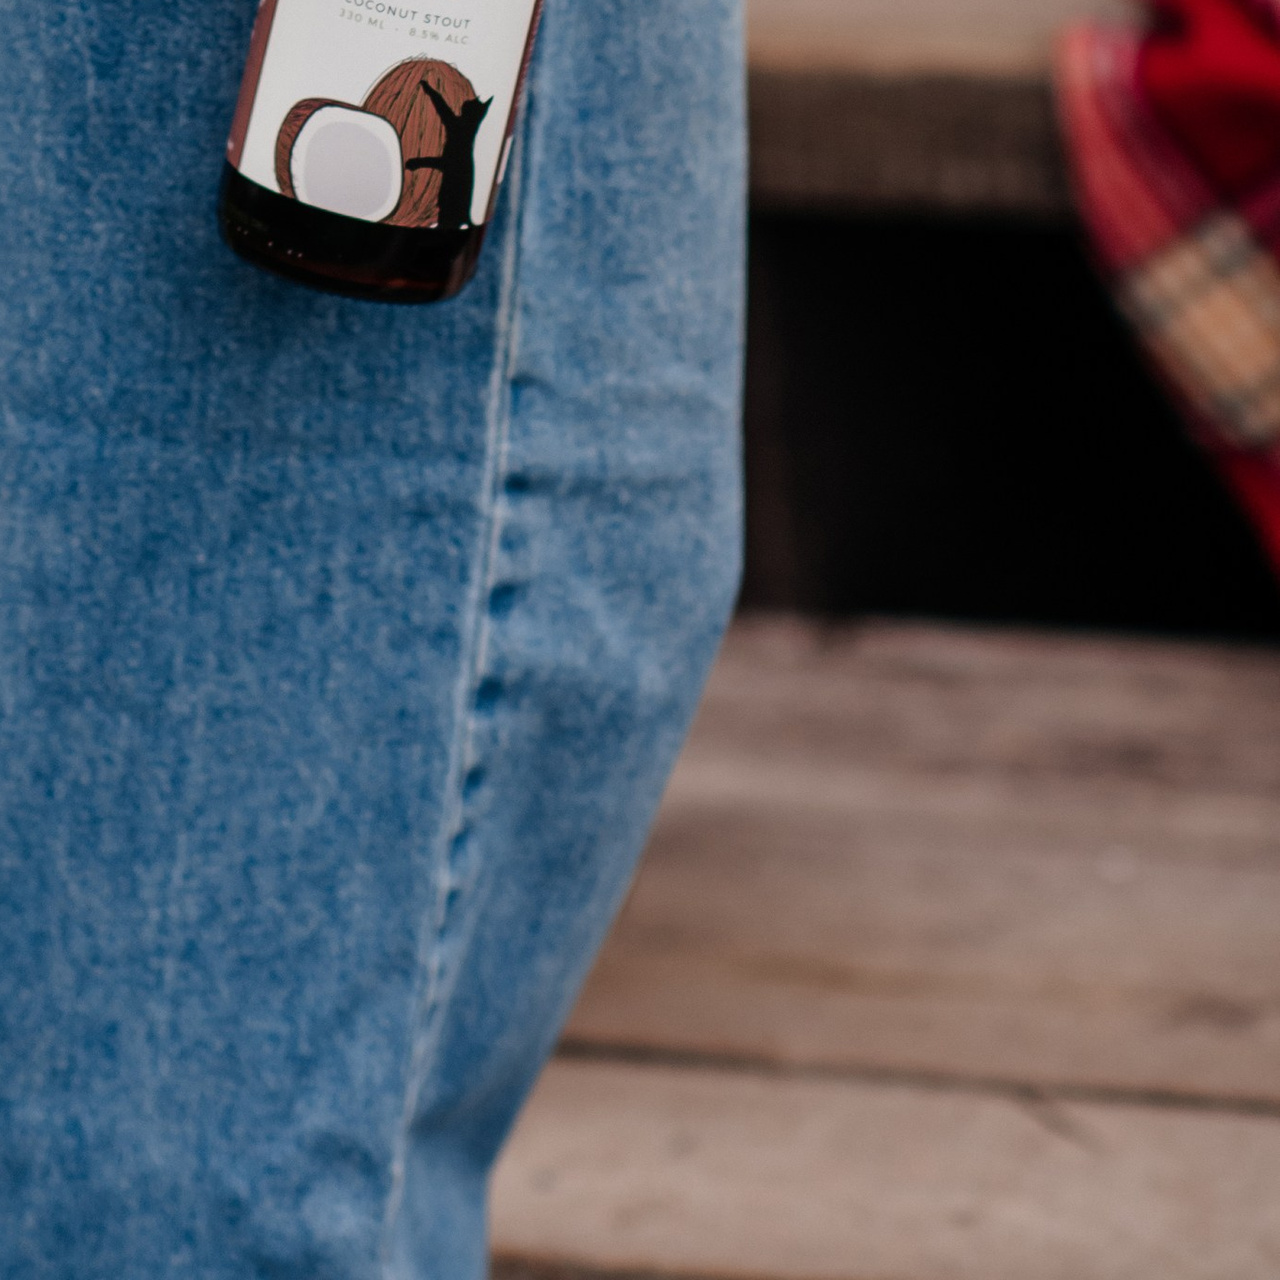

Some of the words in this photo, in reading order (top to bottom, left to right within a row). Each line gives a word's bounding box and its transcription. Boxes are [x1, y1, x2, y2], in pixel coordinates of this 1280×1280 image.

[367, 16, 385, 30] ML
[445, 33, 470, 46] ALC
[423, 13, 471, 29] STOUT
